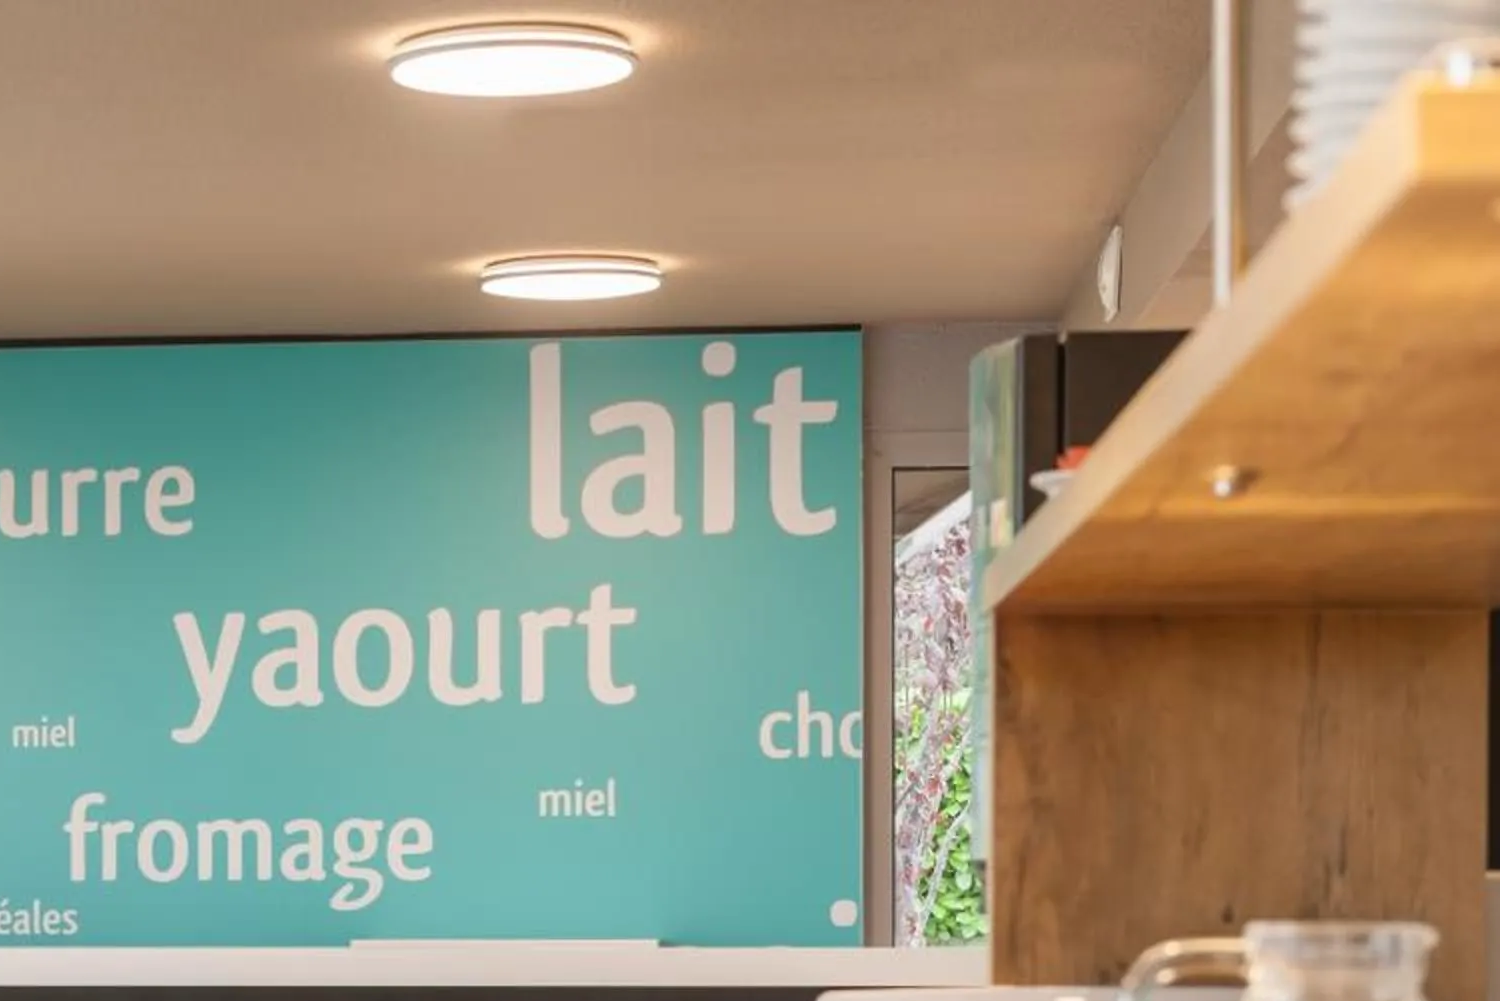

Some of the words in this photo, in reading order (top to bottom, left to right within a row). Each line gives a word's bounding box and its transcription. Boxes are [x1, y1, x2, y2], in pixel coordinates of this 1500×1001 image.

[528, 341, 839, 541] lait
[171, 583, 638, 744] yaourt
[11, 715, 76, 749] miel
[63, 793, 435, 911] fromage
[537, 778, 618, 818] miel
